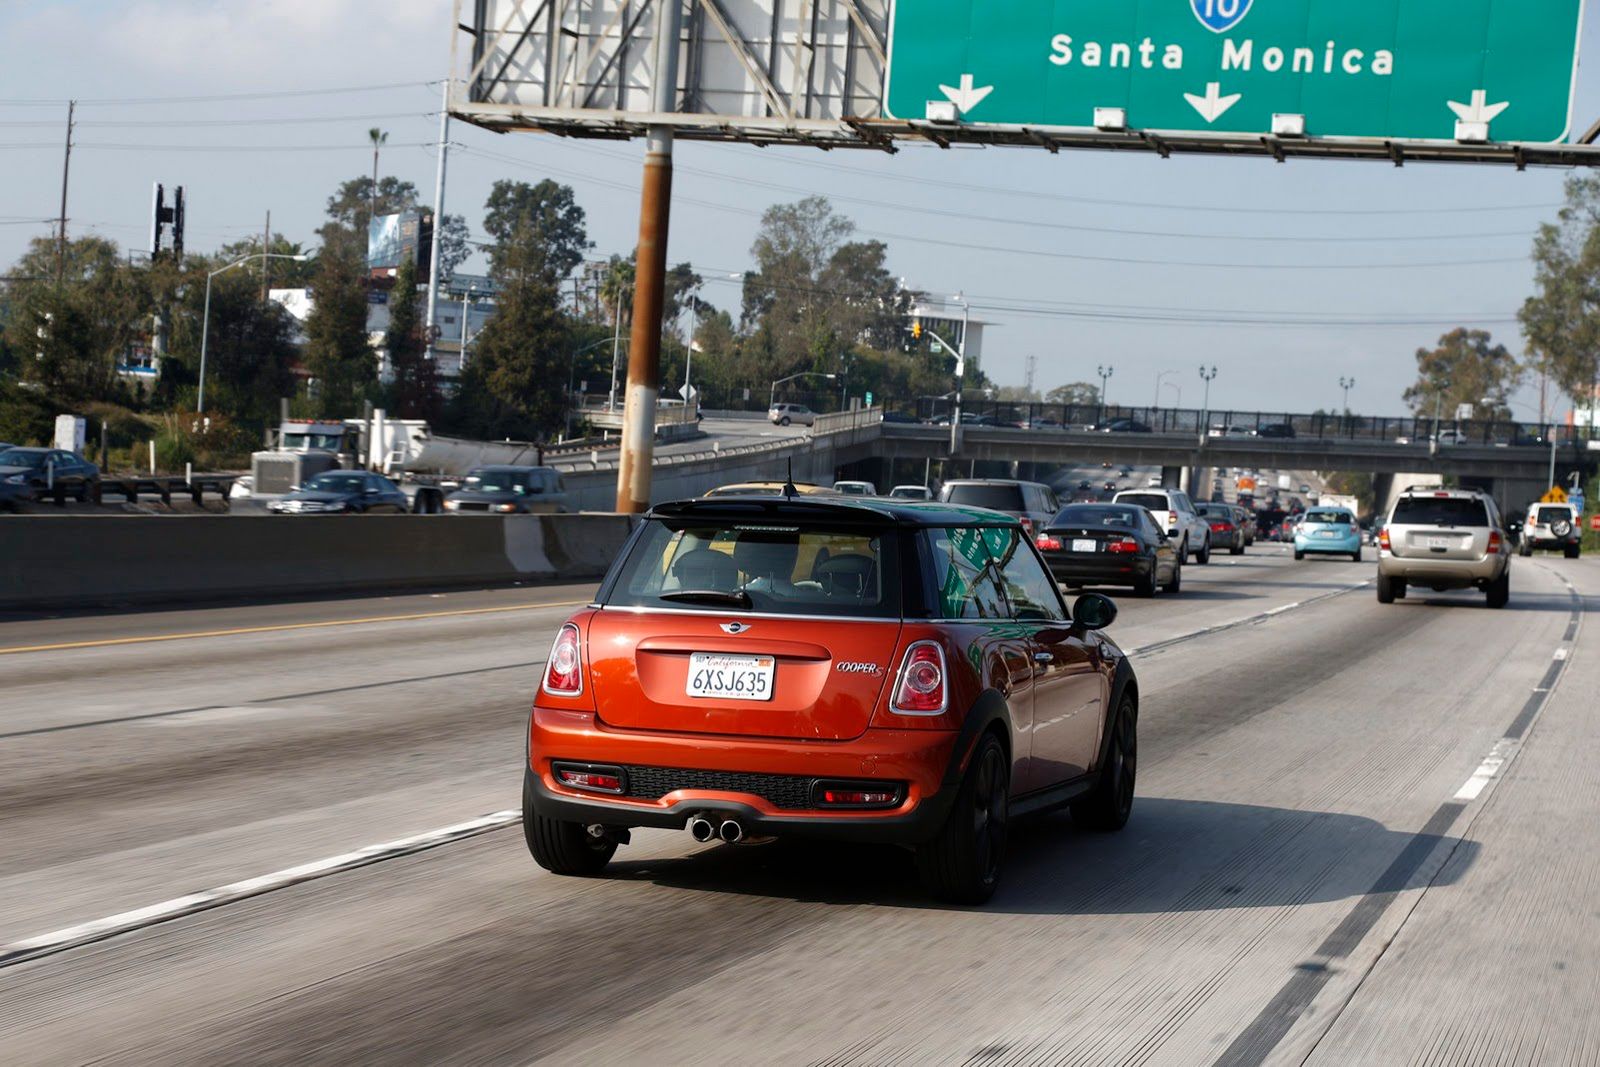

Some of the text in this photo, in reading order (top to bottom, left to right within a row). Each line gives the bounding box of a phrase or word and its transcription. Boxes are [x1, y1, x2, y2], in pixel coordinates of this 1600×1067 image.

[1048, 33, 1393, 75] Santa Monica
[707, 655, 753, 669] California
[836, 661, 876, 673] COOPER
[692, 669, 766, 693] 6XSJ635
